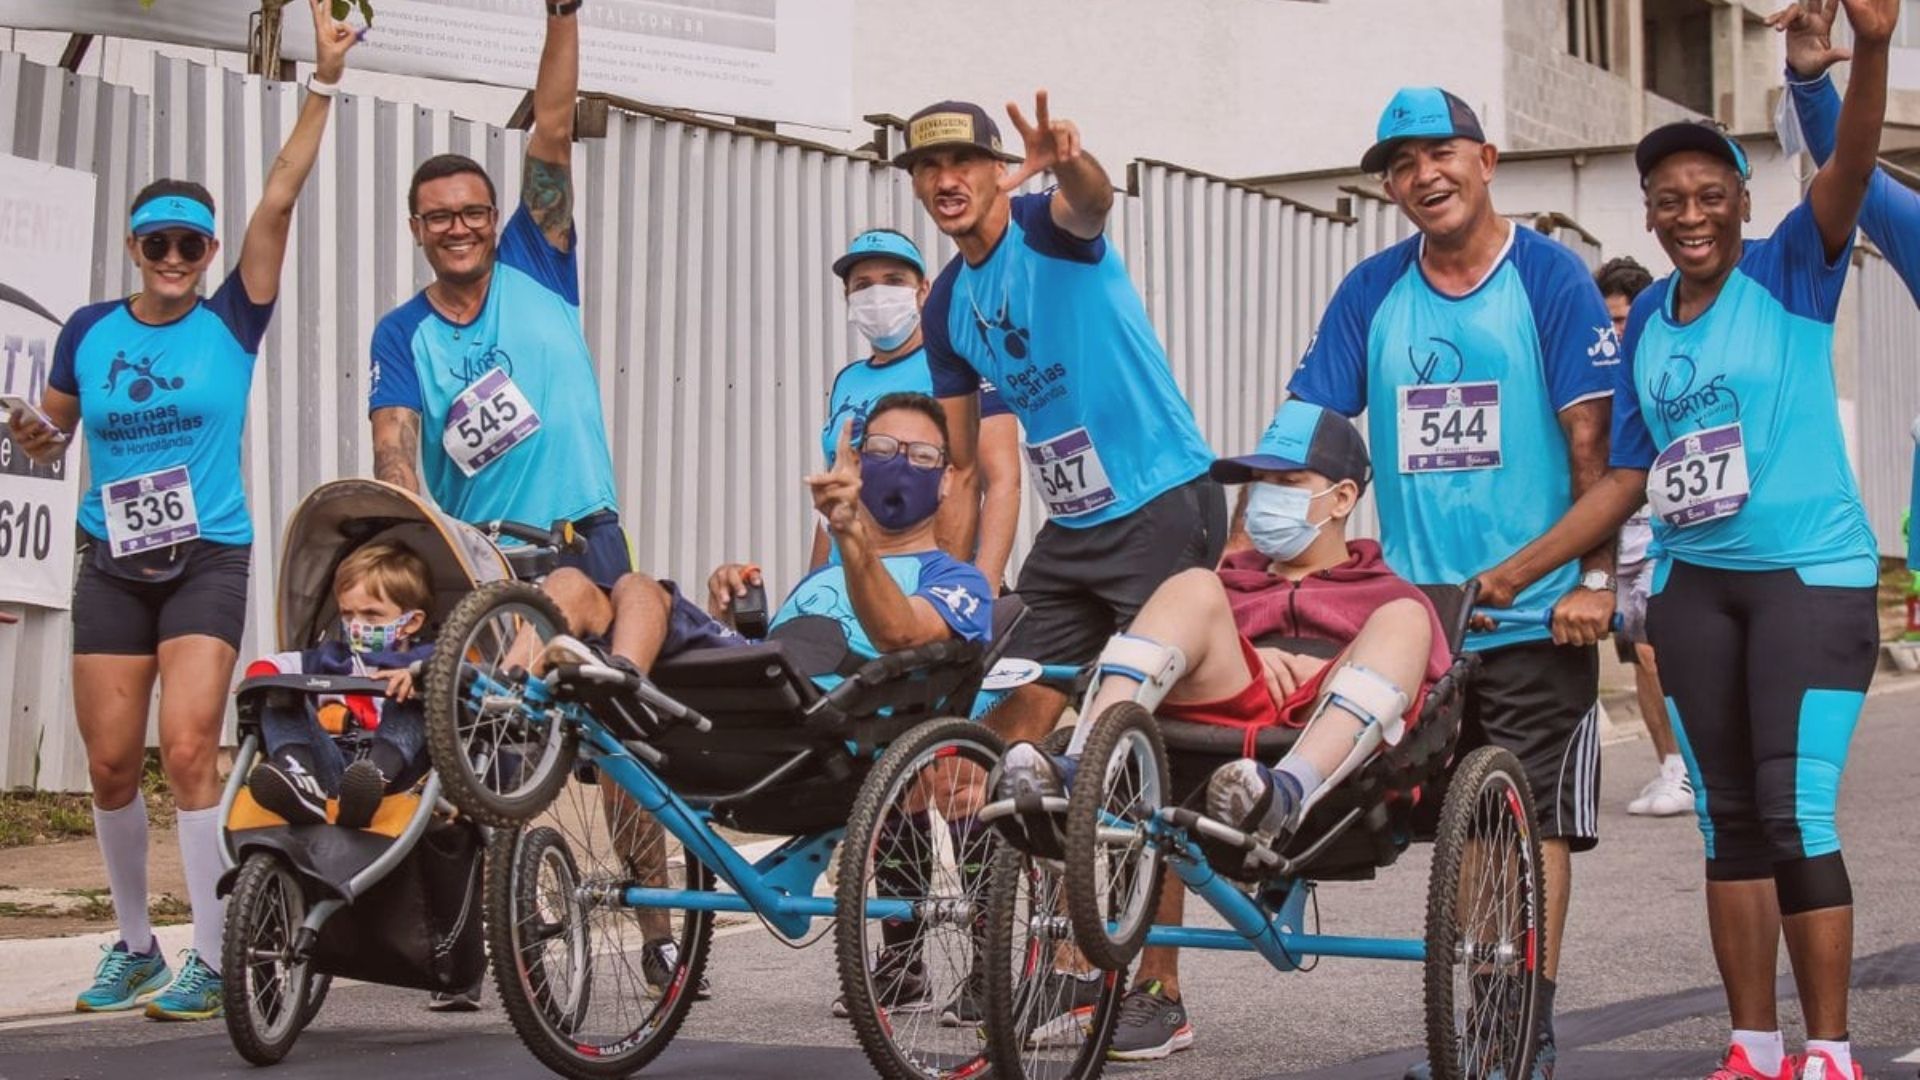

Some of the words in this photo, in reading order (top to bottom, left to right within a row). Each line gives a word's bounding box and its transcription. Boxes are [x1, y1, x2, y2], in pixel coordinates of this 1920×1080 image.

[108, 404, 178, 426] Pernas
[457, 392, 518, 449] 545
[1420, 408, 1487, 447] 544
[1041, 454, 1086, 496] 547
[1666, 452, 1730, 503] 537
[0, 500, 51, 561] 610
[124, 491, 184, 532] 536
